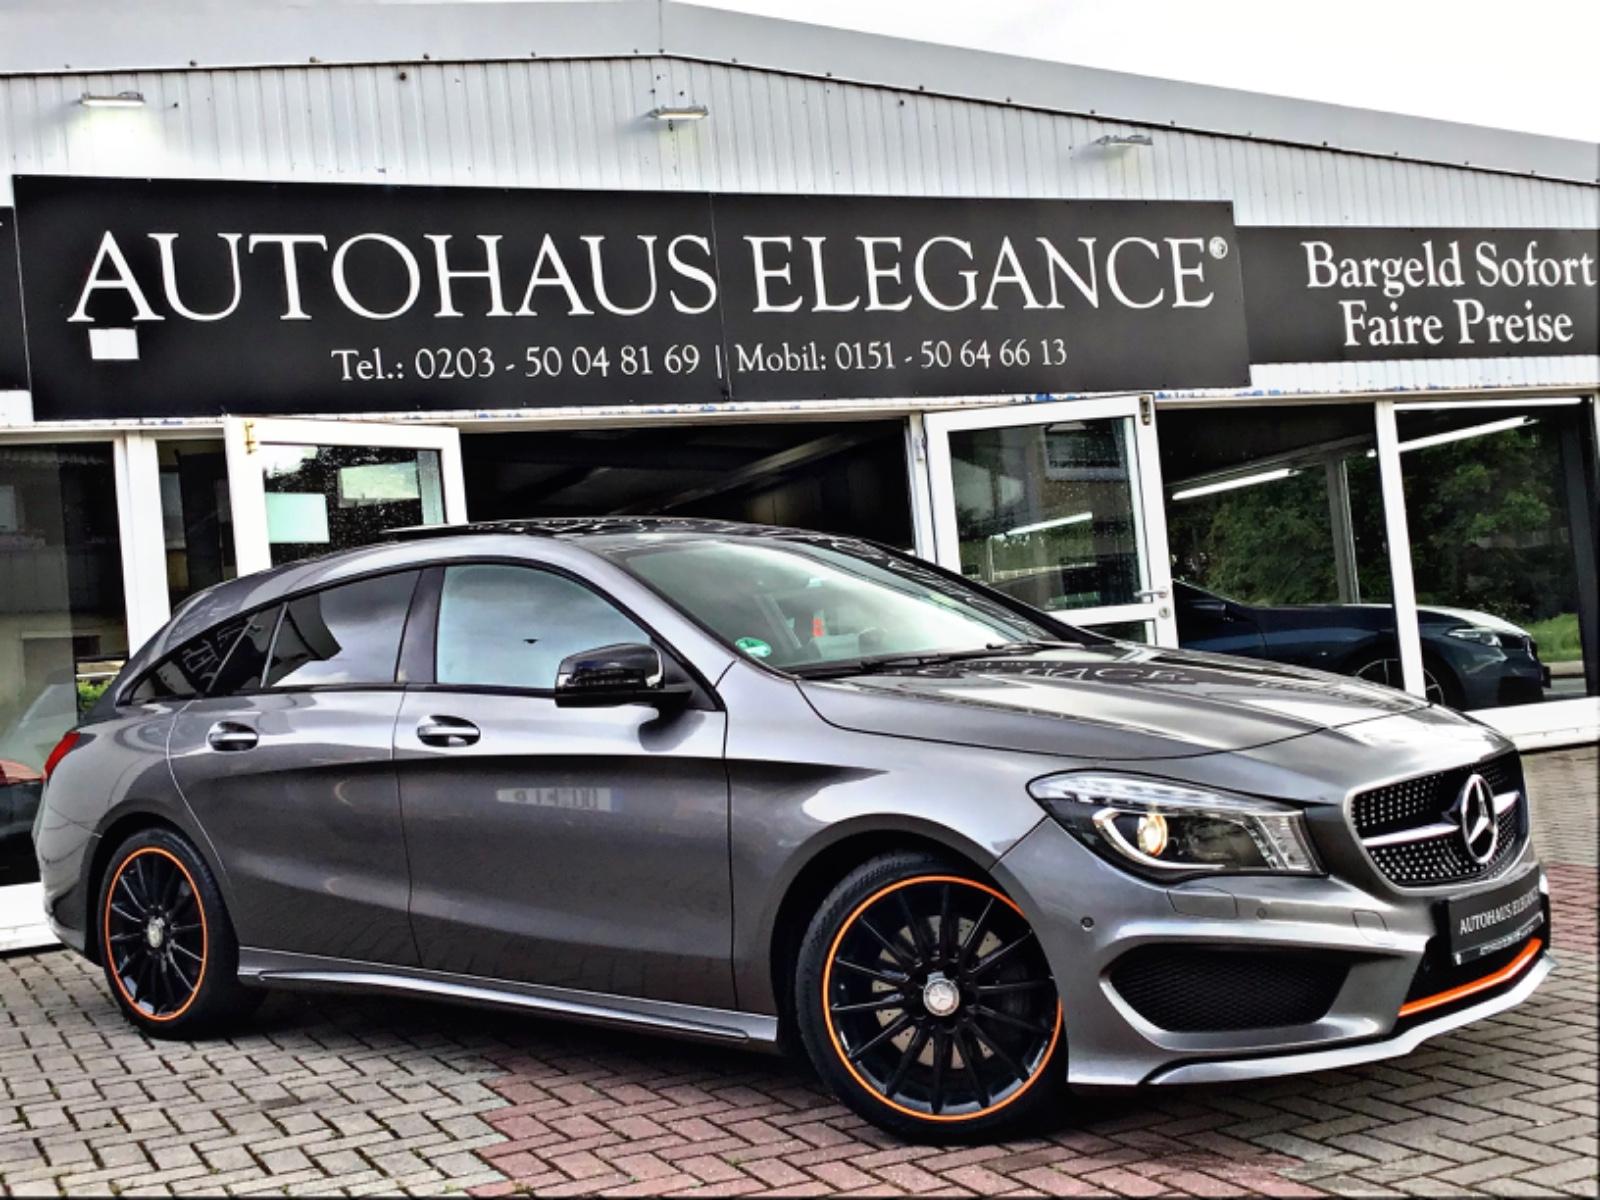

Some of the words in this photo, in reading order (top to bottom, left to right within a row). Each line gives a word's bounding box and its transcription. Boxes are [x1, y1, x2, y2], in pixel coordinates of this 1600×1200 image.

[66, 230, 717, 322] AUTOHAUS
[1300, 240, 1466, 298] Bargeld
[1475, 240, 1597, 288] Sofort
[1338, 299, 1444, 346] Faire
[1452, 298, 1574, 345] Preise
[330, 346, 404, 381] Tel.:
[414, 346, 496, 380] 0203
[525, 346, 563, 378] 50
[571, 346, 611, 378] 04
[620, 344, 653, 376] 81
[664, 344, 701, 375] 69
[734, 341, 827, 372] Mobil:
[834, 341, 896, 371] 0151
[920, 340, 952, 369] 50
[959, 338, 992, 369] 64
[999, 338, 1031, 368] 66
[1040, 338, 1068, 367] 13
[1459, 903, 1513, 936] AUTOHAUS
